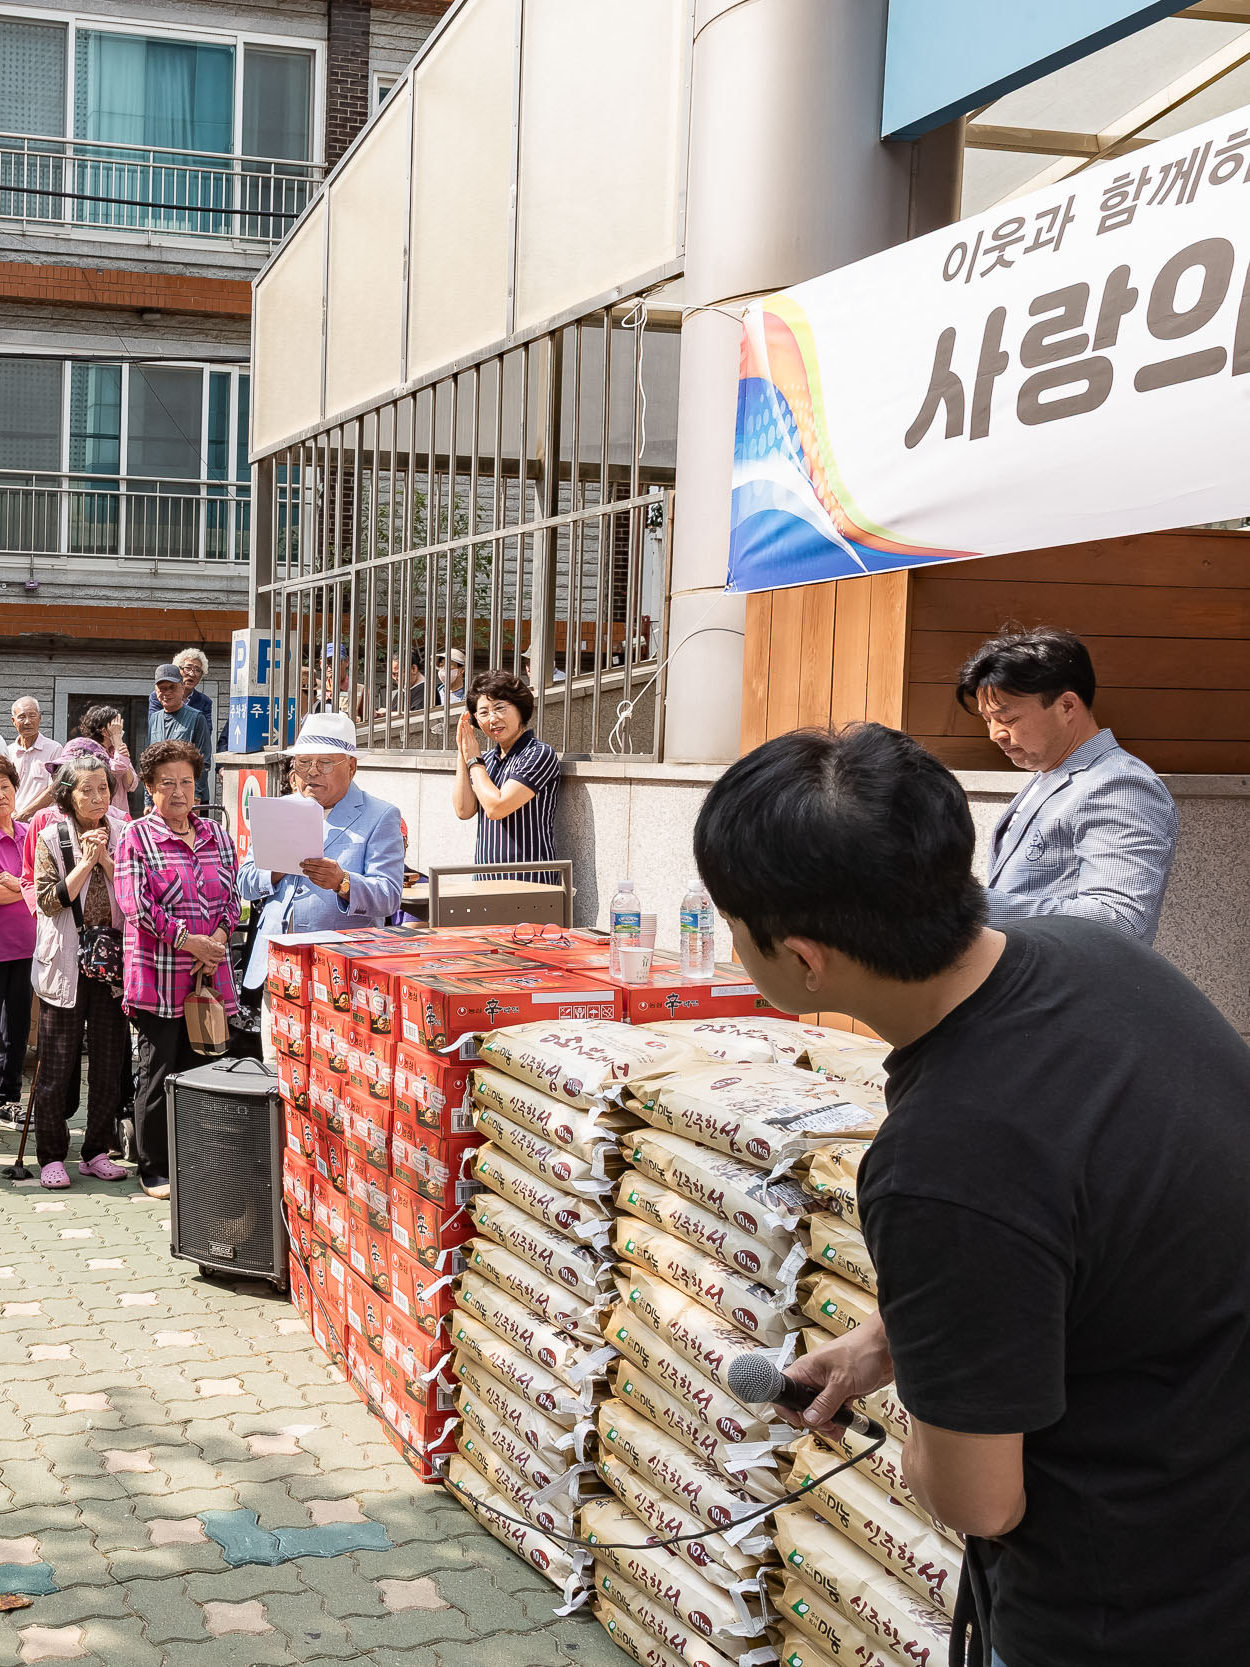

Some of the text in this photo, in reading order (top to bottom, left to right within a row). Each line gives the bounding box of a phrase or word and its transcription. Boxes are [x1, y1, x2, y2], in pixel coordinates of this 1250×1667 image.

[941, 194, 1076, 285] 이웃과
[233, 639, 247, 685] P
[230, 703, 247, 719] 주차장
[748, 1139, 769, 1158] 10kg
[553, 1163, 570, 1180] 10kg
[735, 1211, 756, 1235] 10kg
[736, 1252, 758, 1273] 10kg
[560, 1269, 578, 1286] 10kg
[734, 1310, 756, 1331] 10kg
[539, 1349, 555, 1368] 10kg
[720, 1417, 743, 1443] 10kg
[538, 1512, 554, 1531] 10kg
[531, 1550, 548, 1570] 10kg
[690, 1610, 712, 1637] 10kg
